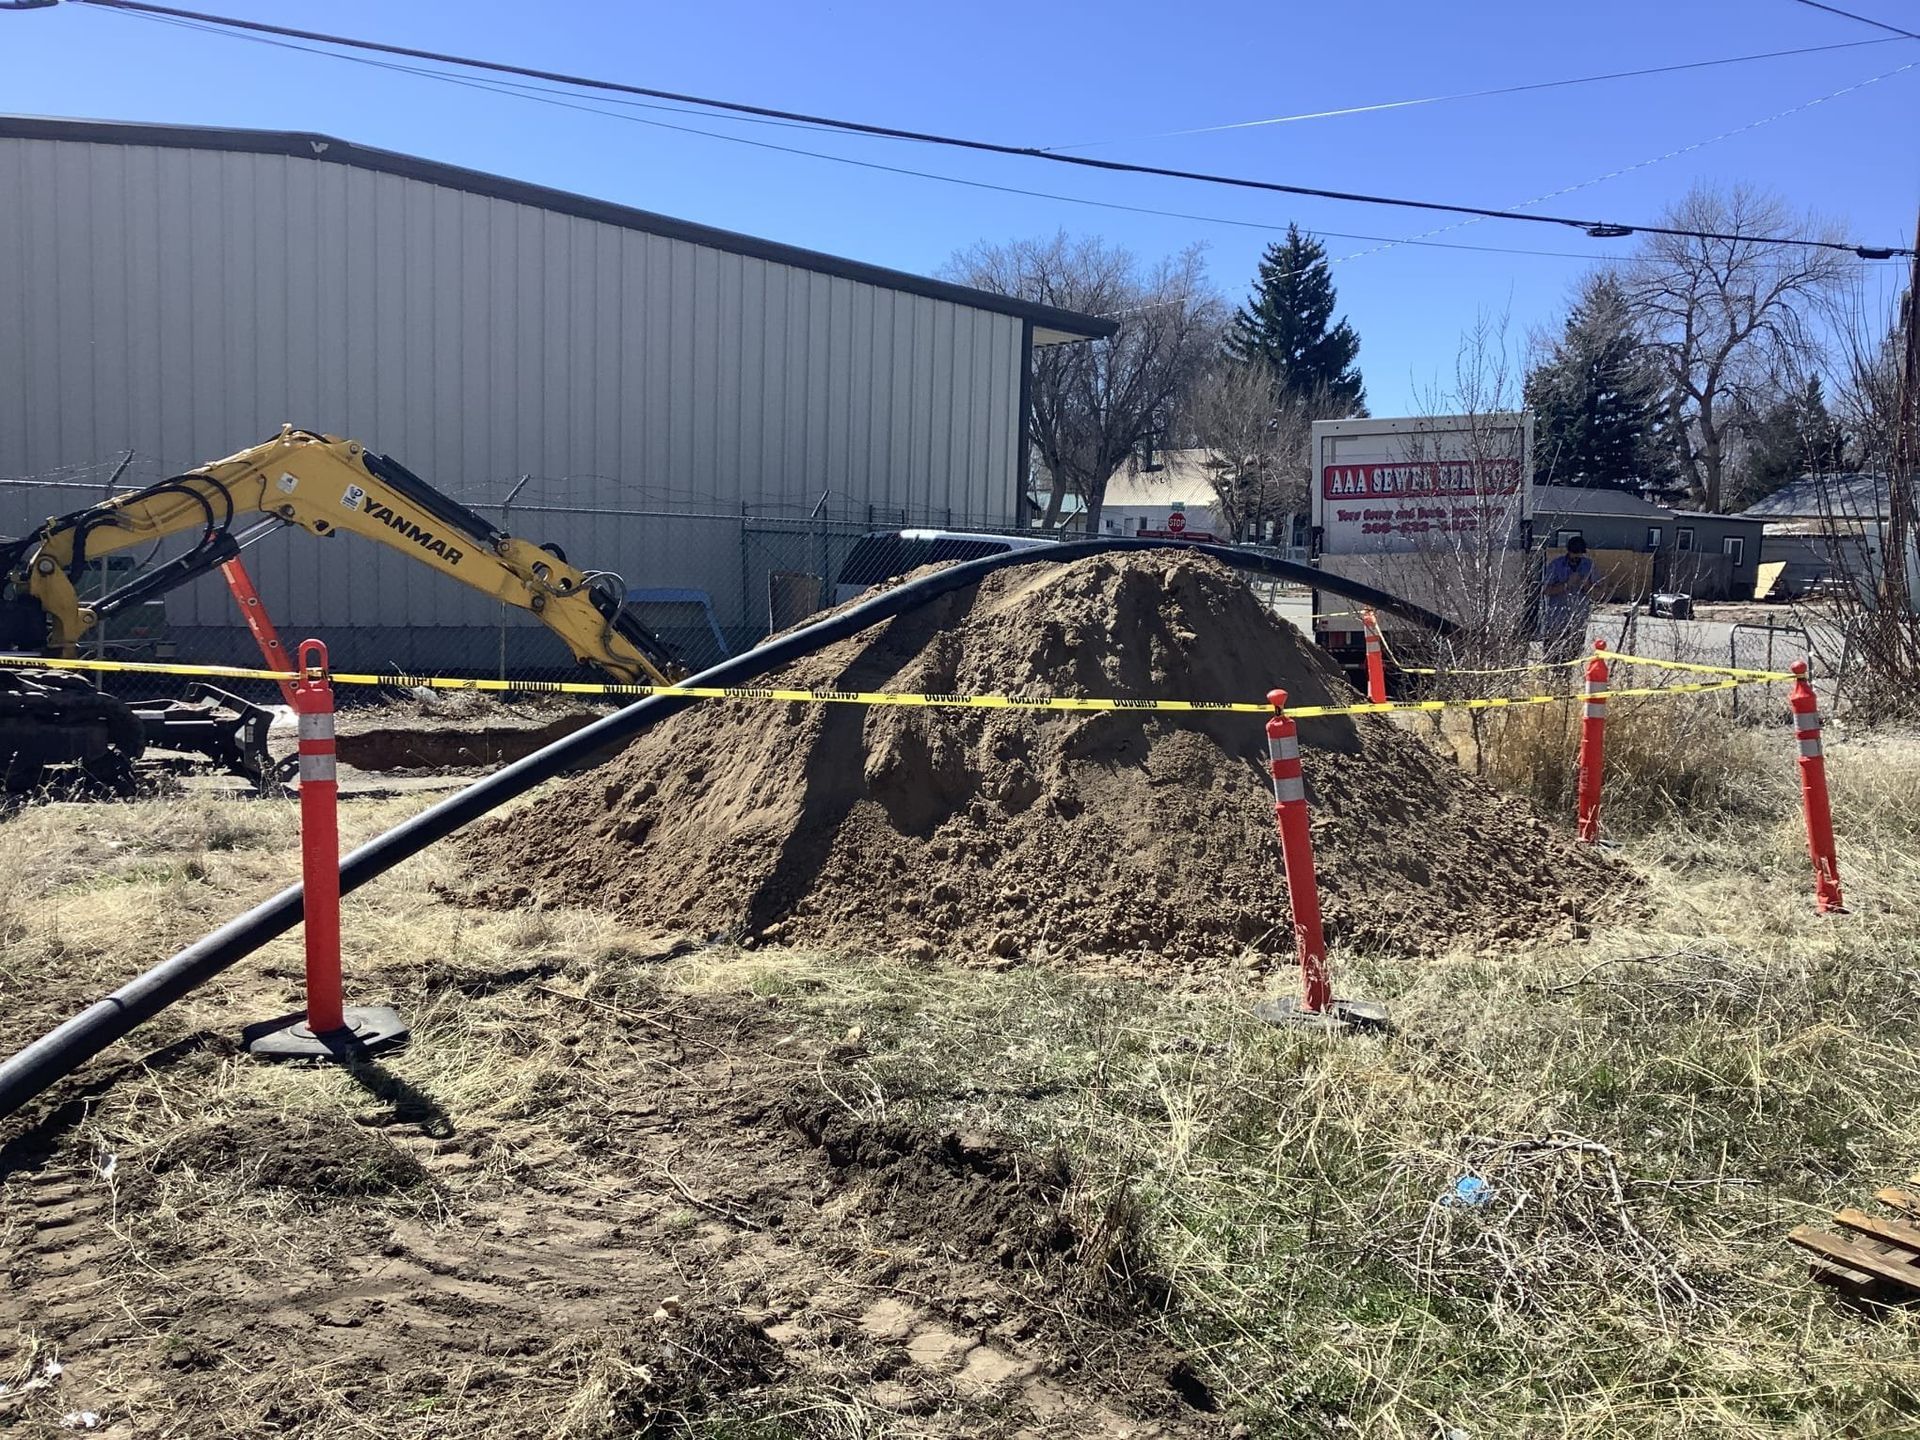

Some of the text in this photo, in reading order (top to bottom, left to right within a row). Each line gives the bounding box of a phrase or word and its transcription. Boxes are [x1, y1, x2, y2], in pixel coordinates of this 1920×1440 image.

[1331, 464, 1512, 494] AAA SEWER SERICE
[363, 496, 463, 565] YANMAR
[1169, 518, 1185, 527] STOP
